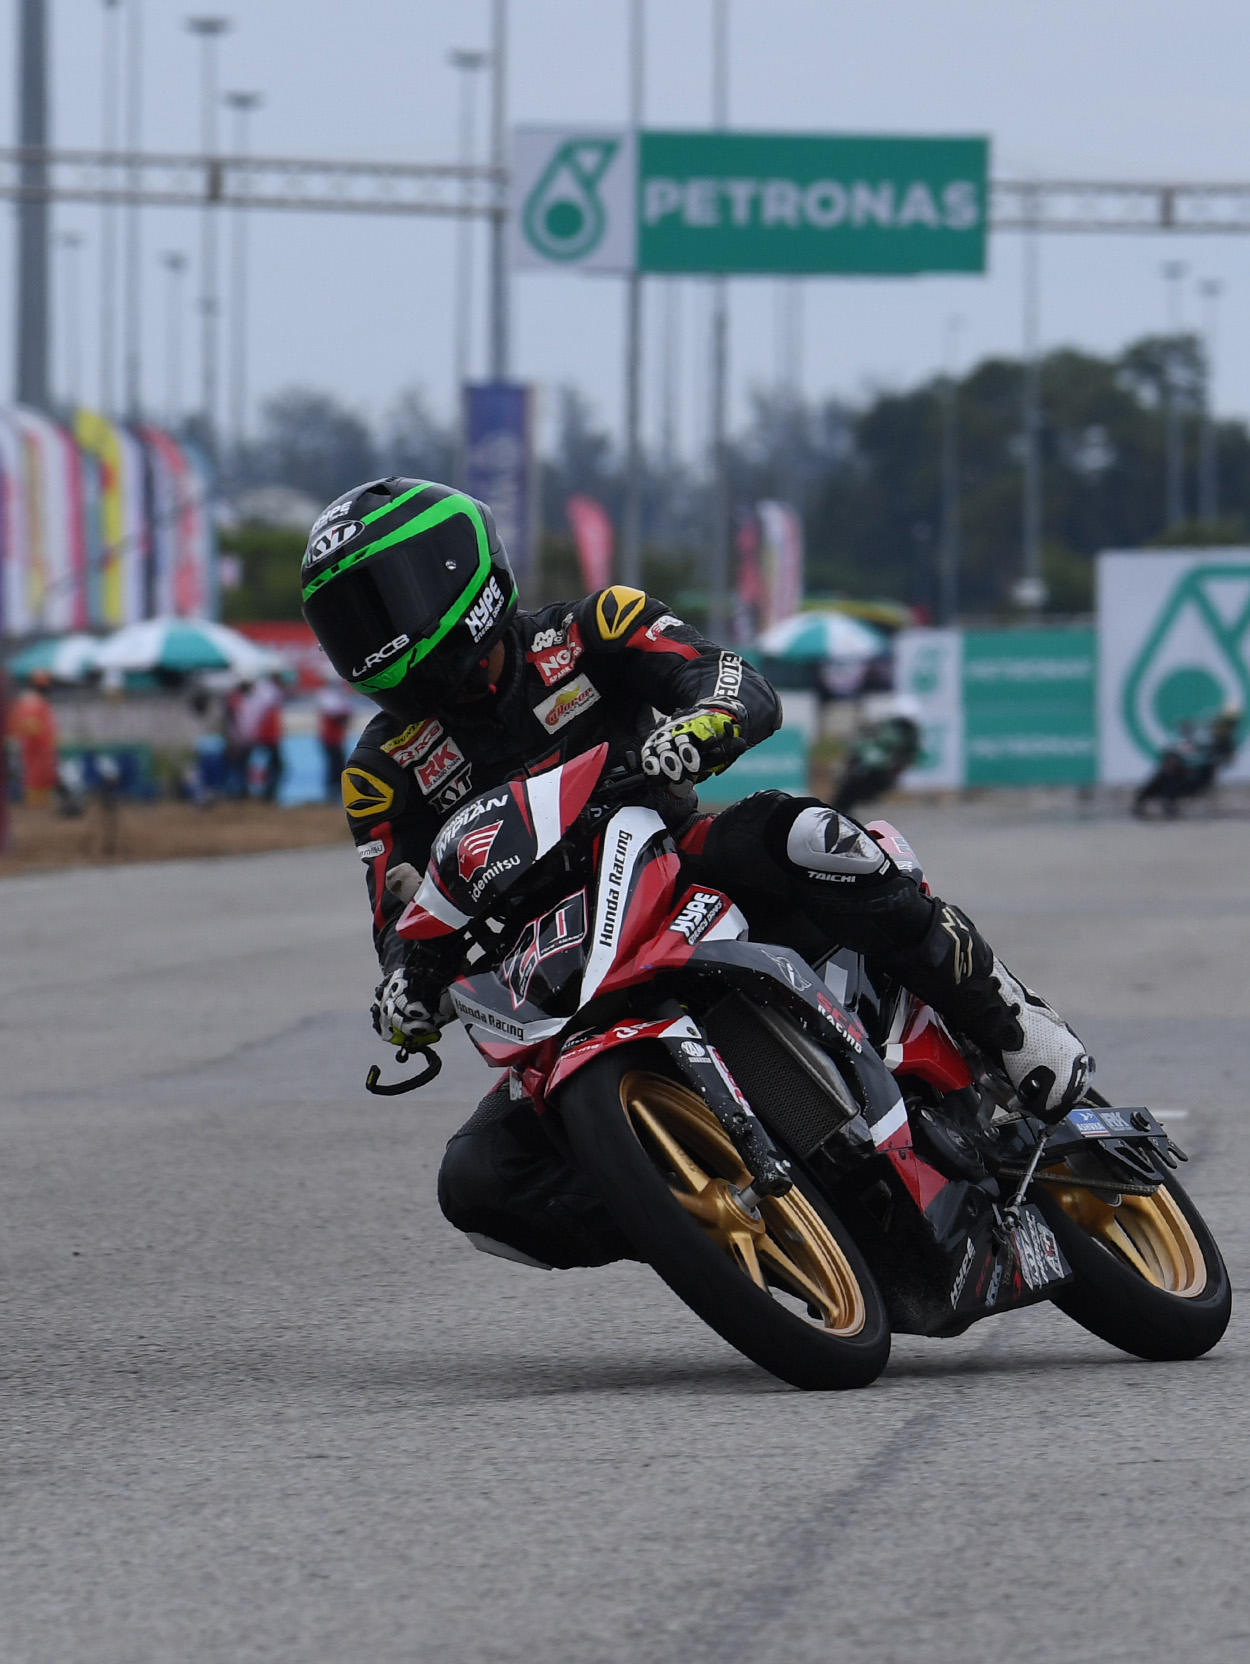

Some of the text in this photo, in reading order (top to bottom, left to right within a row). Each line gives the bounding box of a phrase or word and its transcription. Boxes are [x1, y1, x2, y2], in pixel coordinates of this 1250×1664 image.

[644, 178, 979, 229] PETRONAS
[465, 576, 501, 636] HYPE
[418, 742, 458, 787] RK
[431, 764, 472, 812] KYT
[469, 855, 521, 903] idemitsu
[598, 829, 633, 948] Honda Racing
[807, 870, 856, 883] TAICHI
[669, 892, 721, 937] HYPE
[454, 998, 525, 1042] Honda Racing
